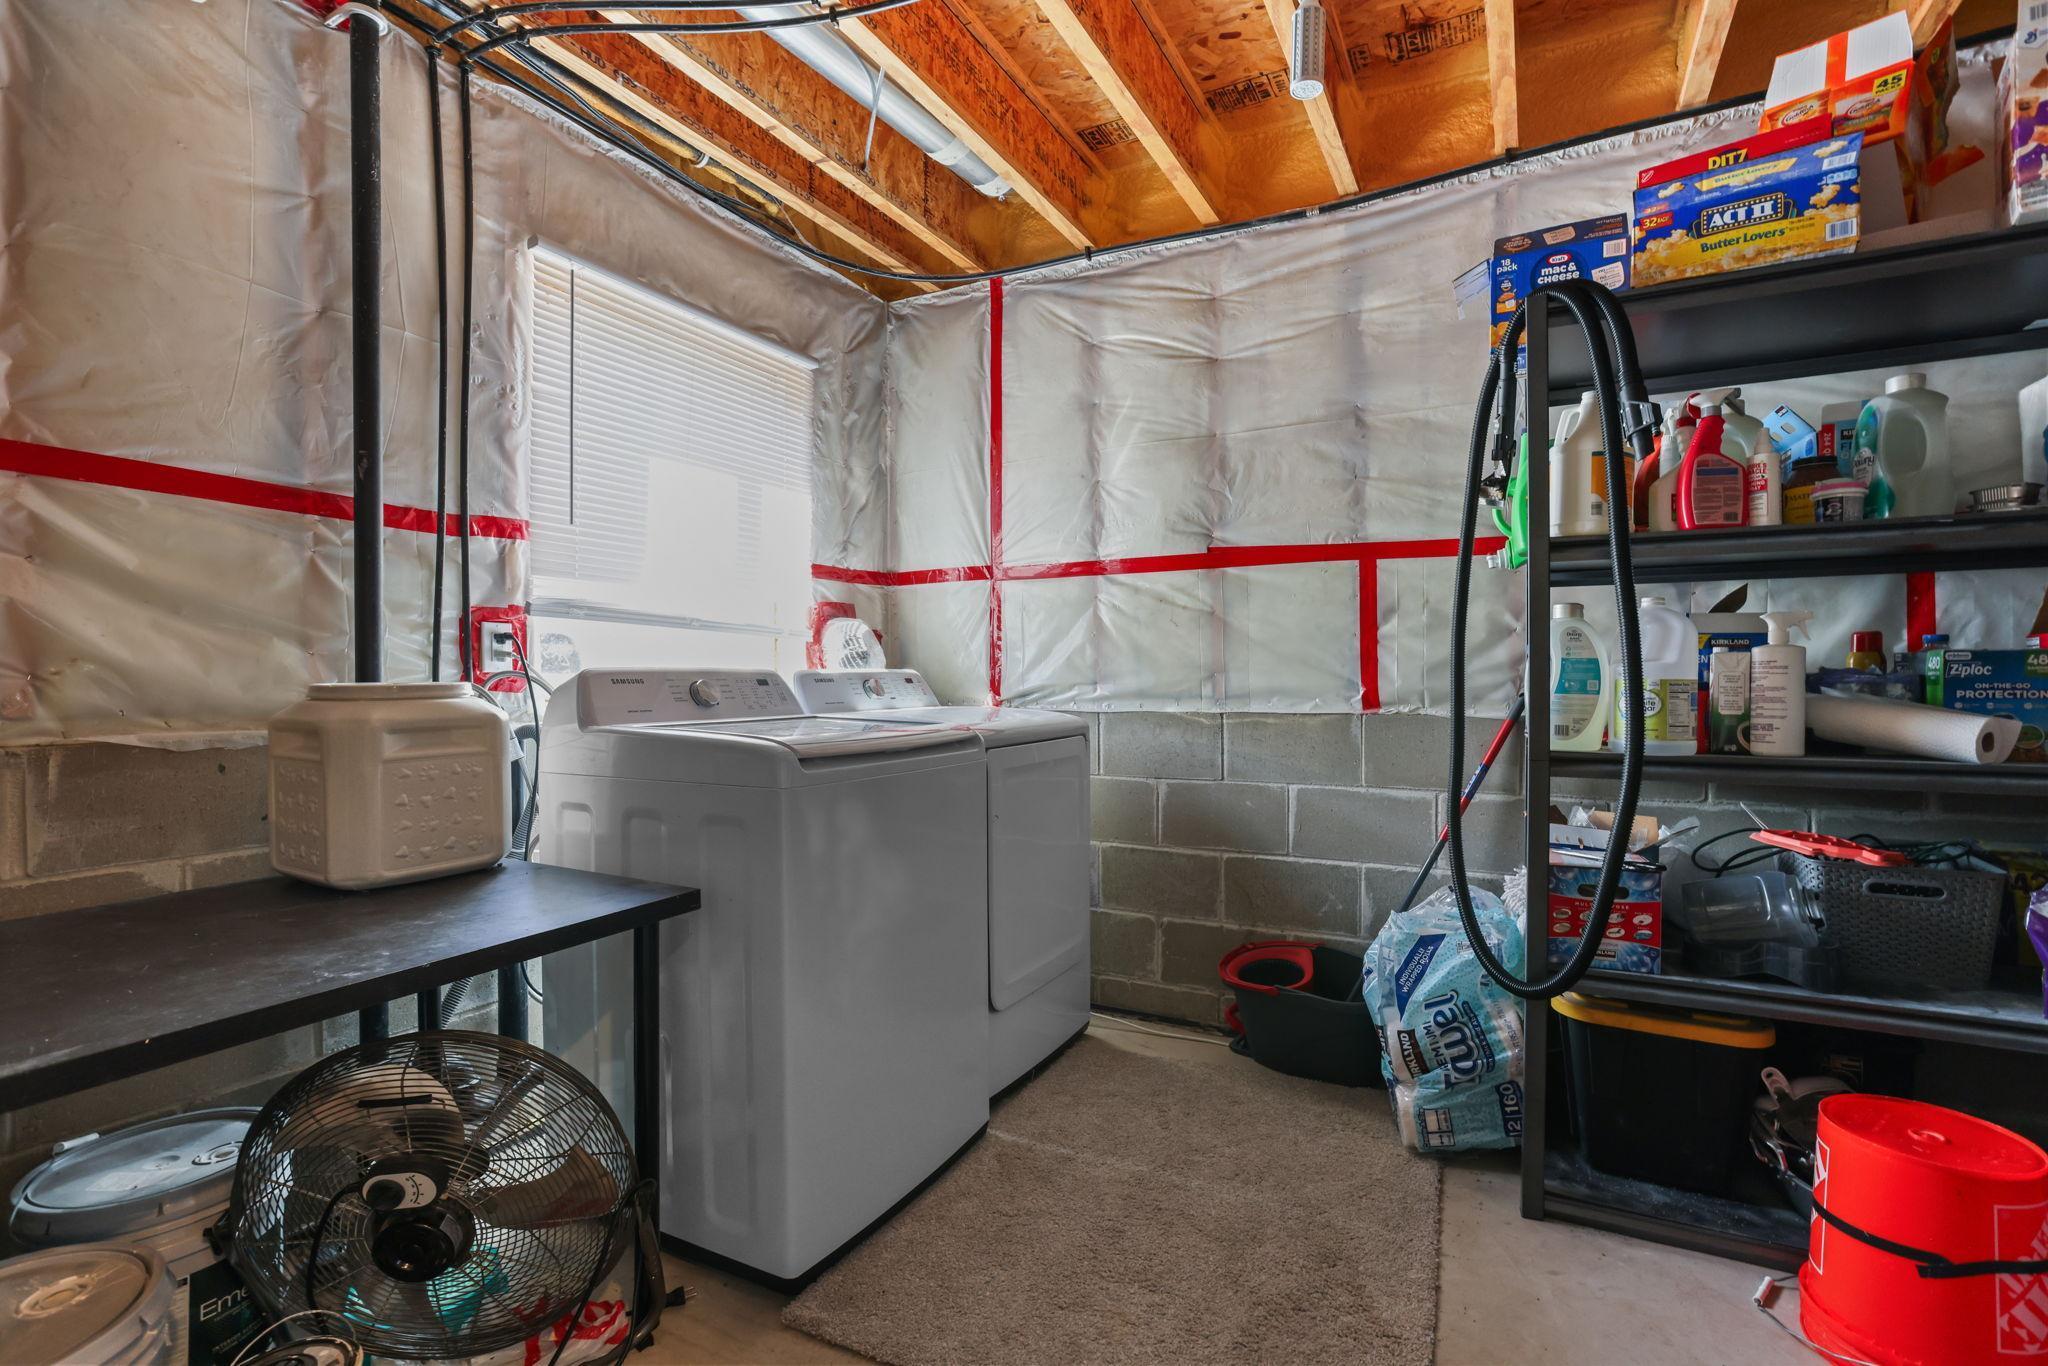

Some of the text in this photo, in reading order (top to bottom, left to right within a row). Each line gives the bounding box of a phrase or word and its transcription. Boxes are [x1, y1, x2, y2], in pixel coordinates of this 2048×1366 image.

[1876, 73, 1903, 89] 45
[1709, 200, 1775, 228] ACT II
[1642, 217, 1657, 230] 32
[1701, 227, 1787, 253] Butter Lovers
[1496, 263, 1518, 275] pack
[1500, 259, 1511, 267] 18
[1541, 262, 1577, 276] mac &
[1928, 656, 1940, 669] 480
[2027, 654, 2048, 665] 48
[1950, 664, 1992, 678] Ziploc
[1956, 690, 2048, 699] PROTECTION
[1402, 963, 1423, 993] WRAPPED
[1499, 1083, 1520, 1114] 160
